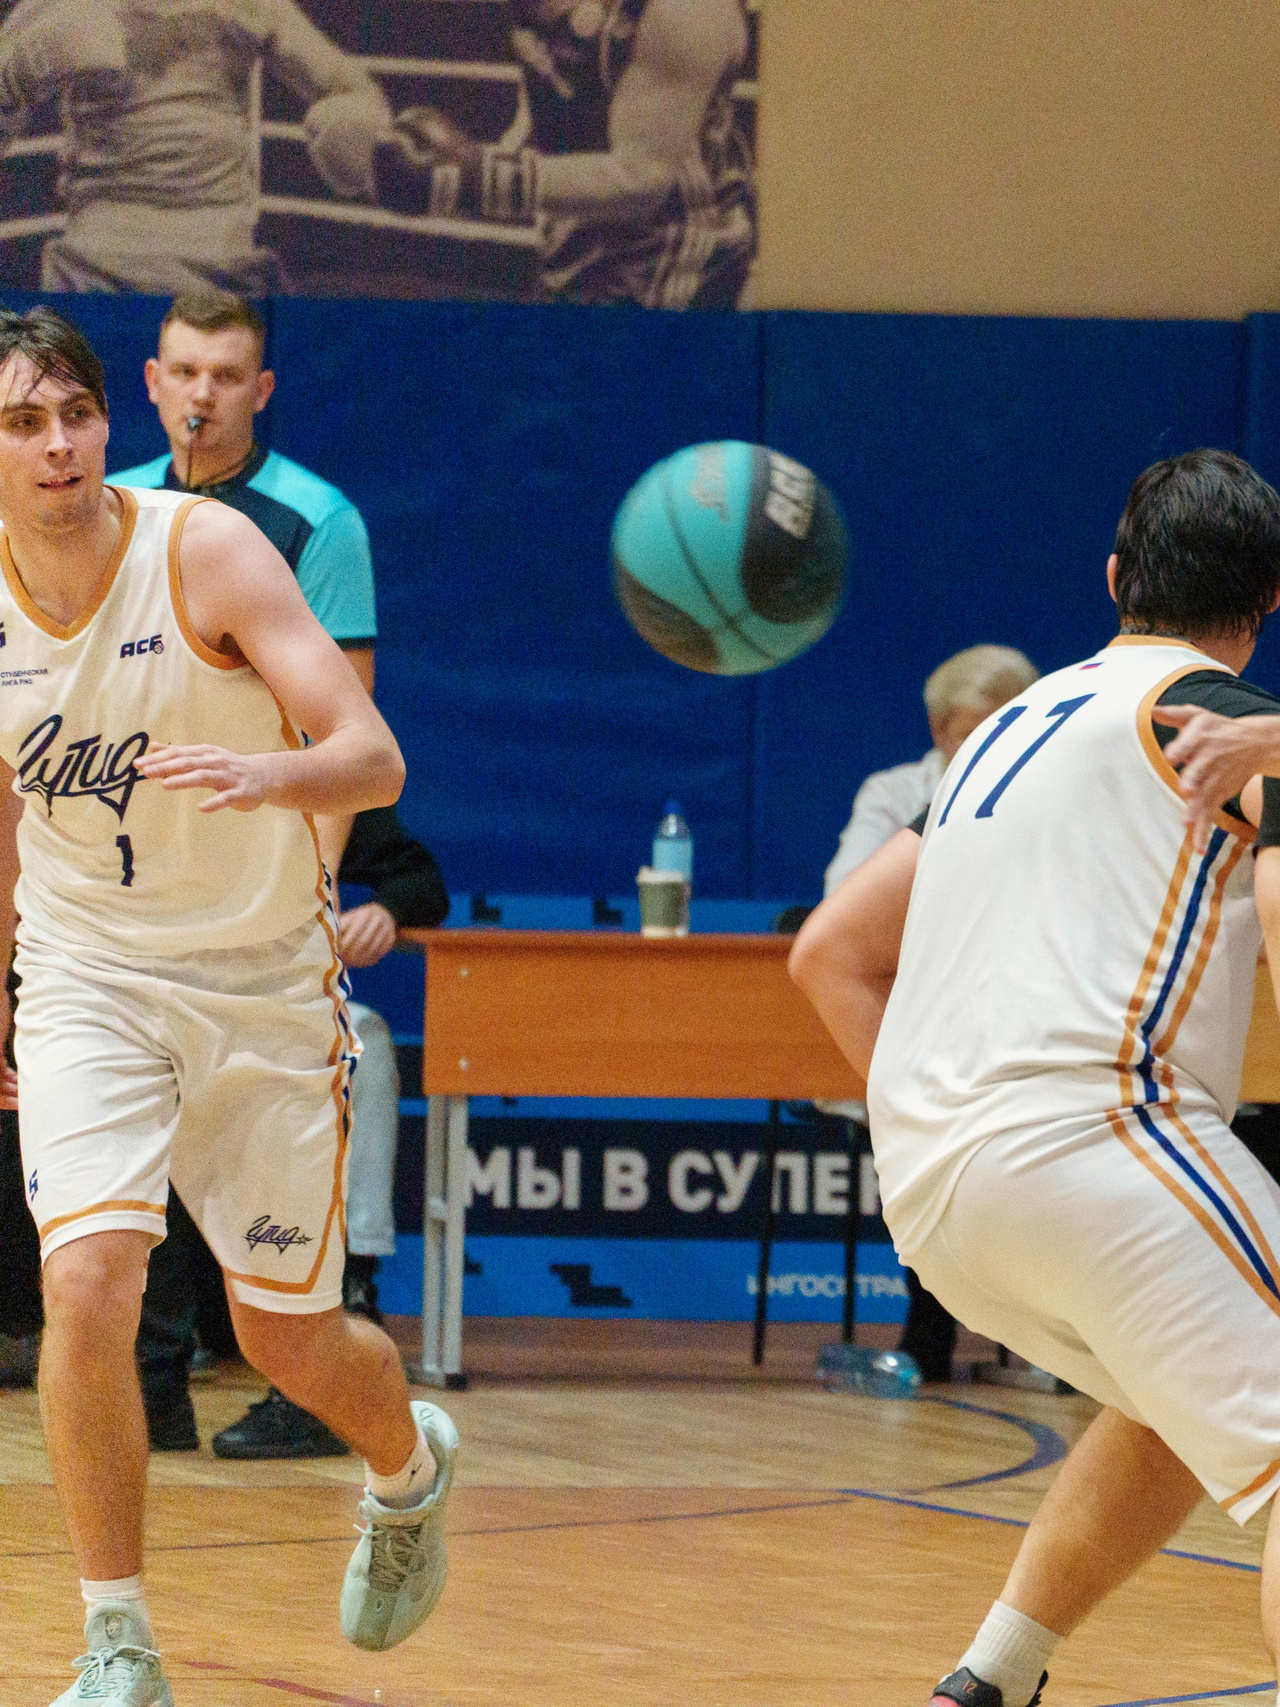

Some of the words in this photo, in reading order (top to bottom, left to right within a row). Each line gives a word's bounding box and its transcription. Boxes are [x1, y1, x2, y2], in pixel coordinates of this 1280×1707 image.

[115, 834, 135, 887] 1
[463, 1147, 581, 1209] МЫ
[603, 1149, 650, 1211] В
